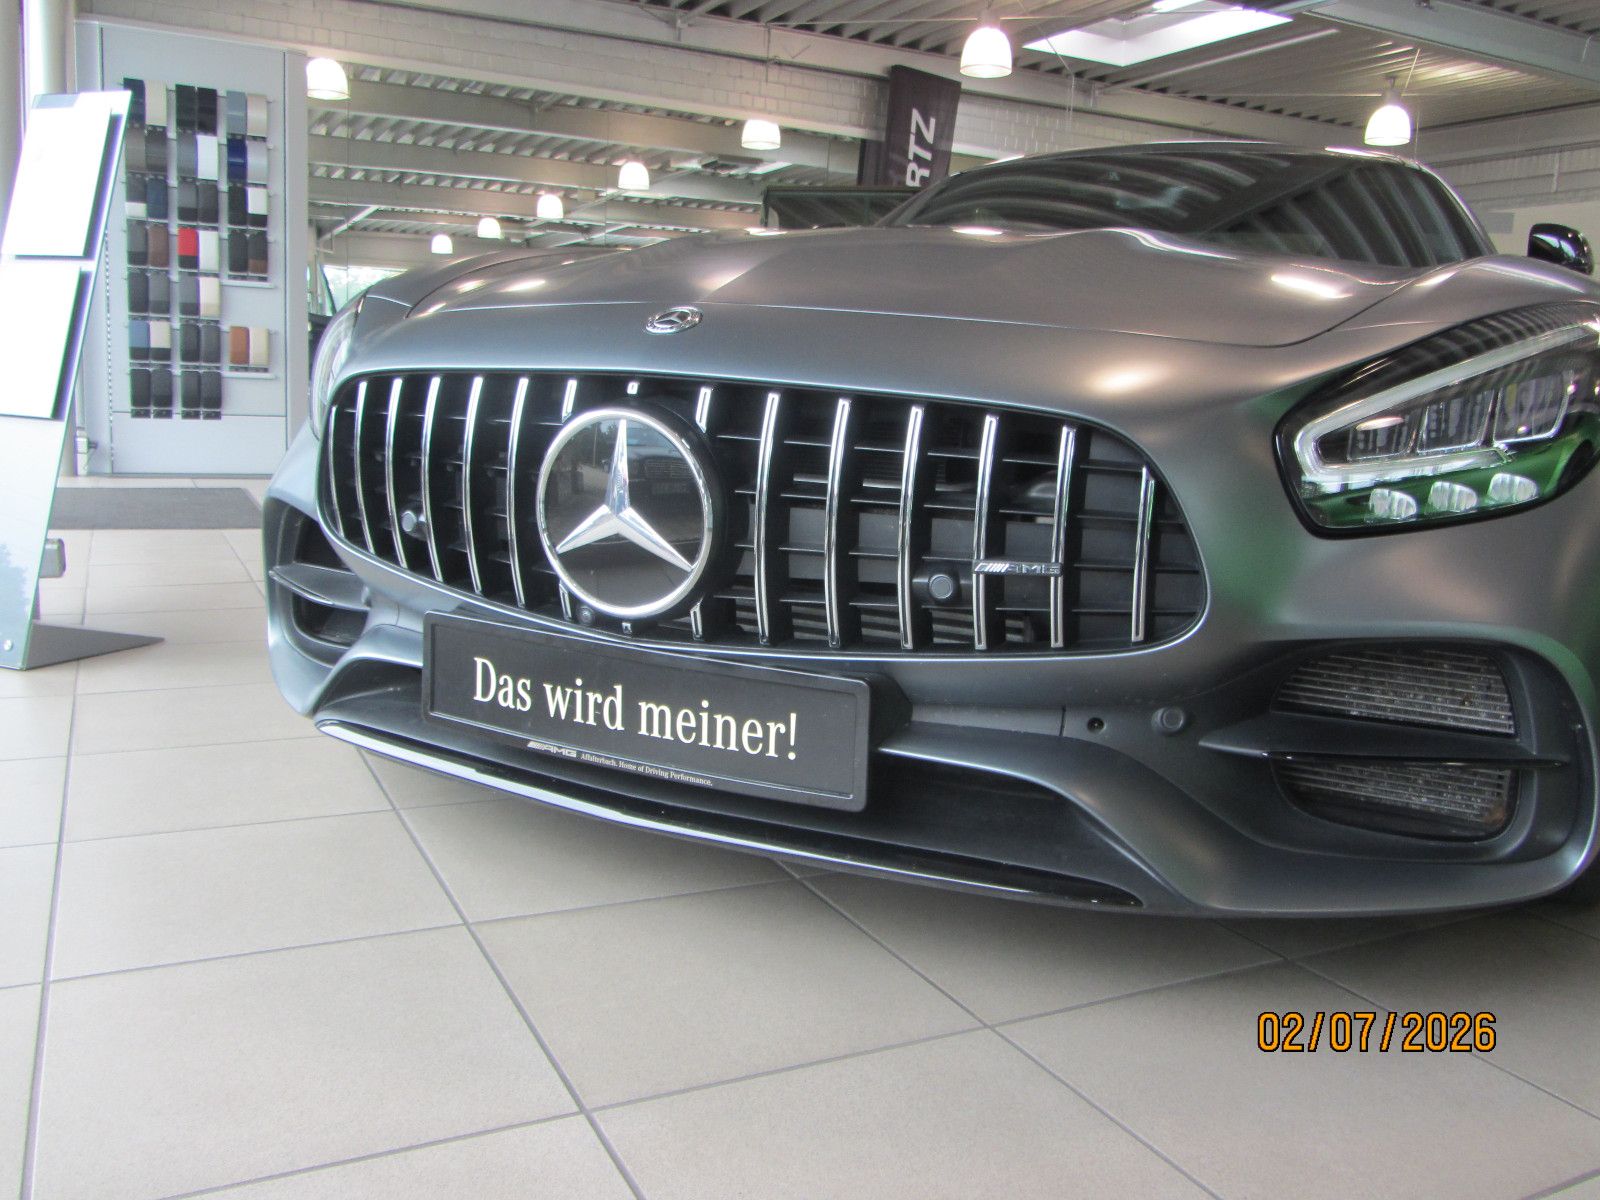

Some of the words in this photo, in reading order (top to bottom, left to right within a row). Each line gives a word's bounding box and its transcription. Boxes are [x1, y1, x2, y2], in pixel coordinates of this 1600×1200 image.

[473, 657, 531, 712] Das
[543, 678, 625, 732] wird
[638, 700, 798, 761] meiner!
[637, 765, 645, 773] of
[645, 765, 669, 779] Driving
